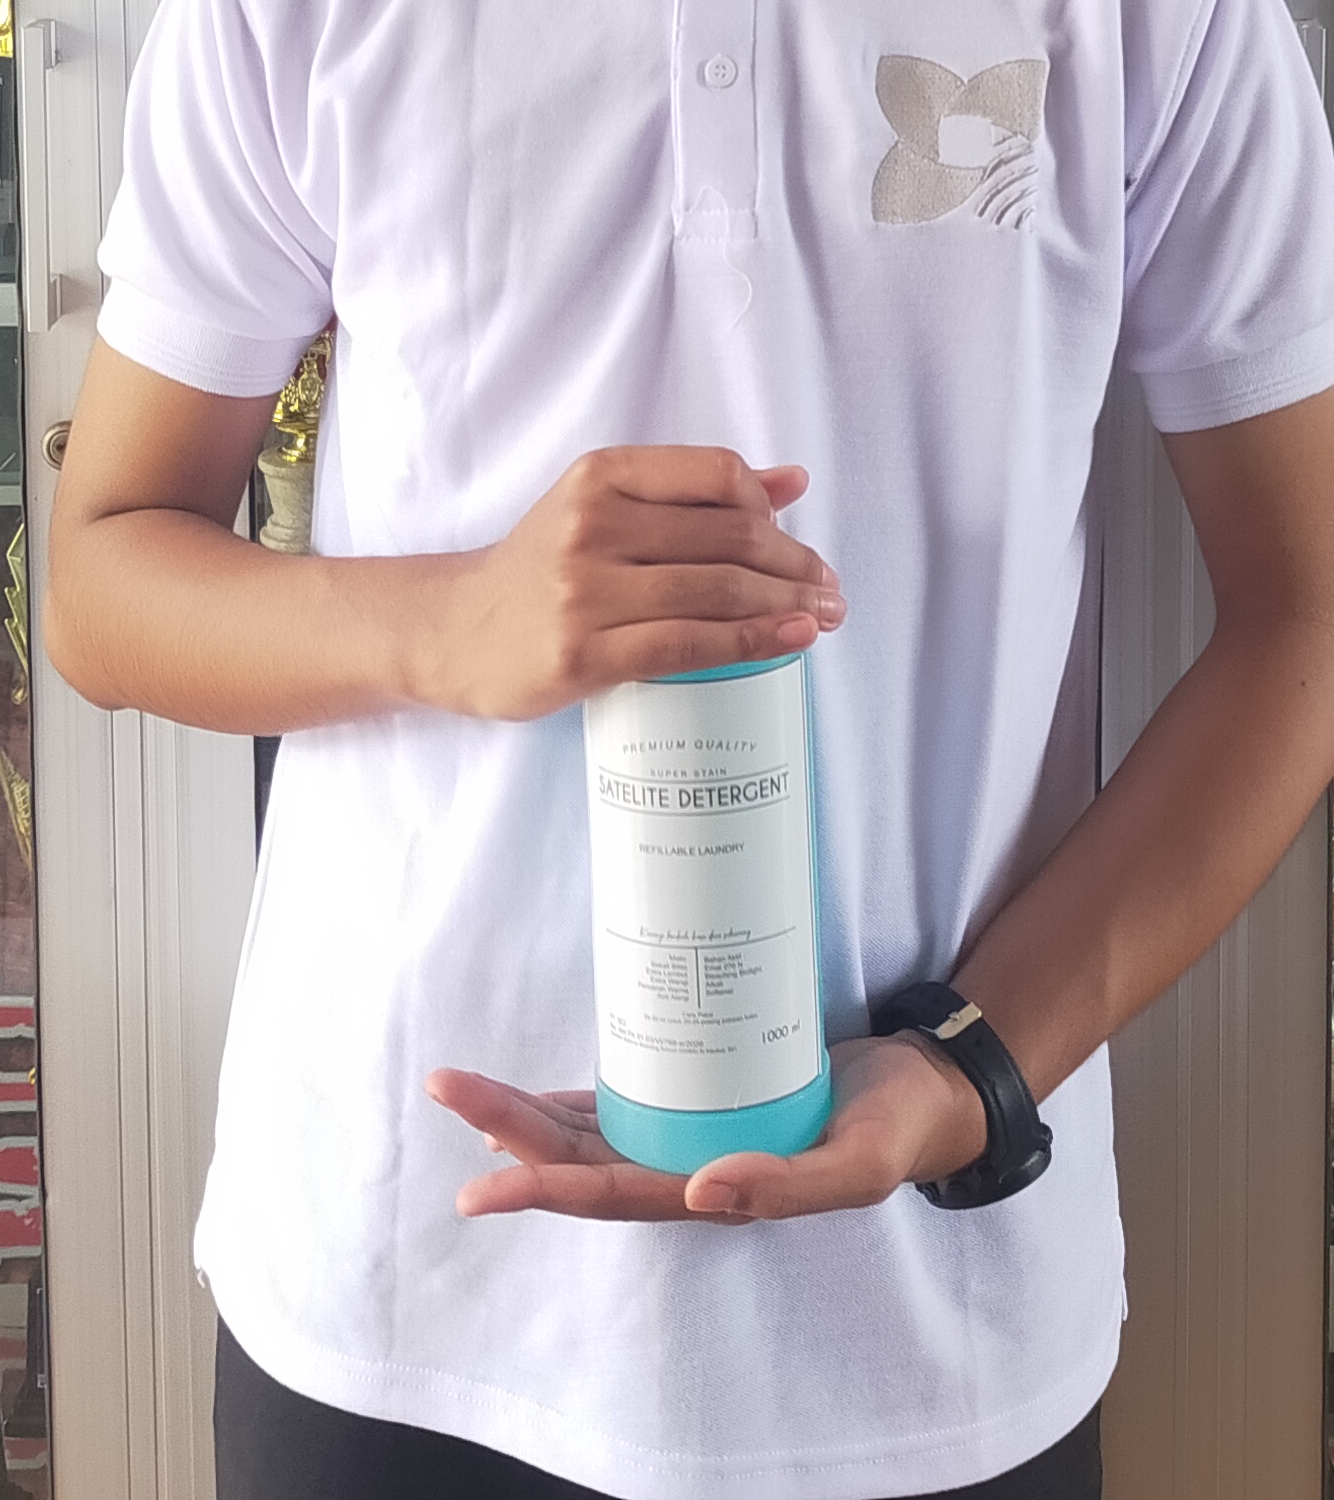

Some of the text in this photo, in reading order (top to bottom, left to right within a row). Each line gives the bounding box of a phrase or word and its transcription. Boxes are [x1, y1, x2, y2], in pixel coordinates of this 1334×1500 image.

[622, 739, 757, 755] PREMIUM QUALITY
[650, 768, 728, 778] SUPER STAIN
[599, 771, 790, 809] SATELITE DETERGENT
[639, 842, 746, 857] REFILLABLE LAUNDRY
[761, 1019, 801, 1044] 1000 ml
